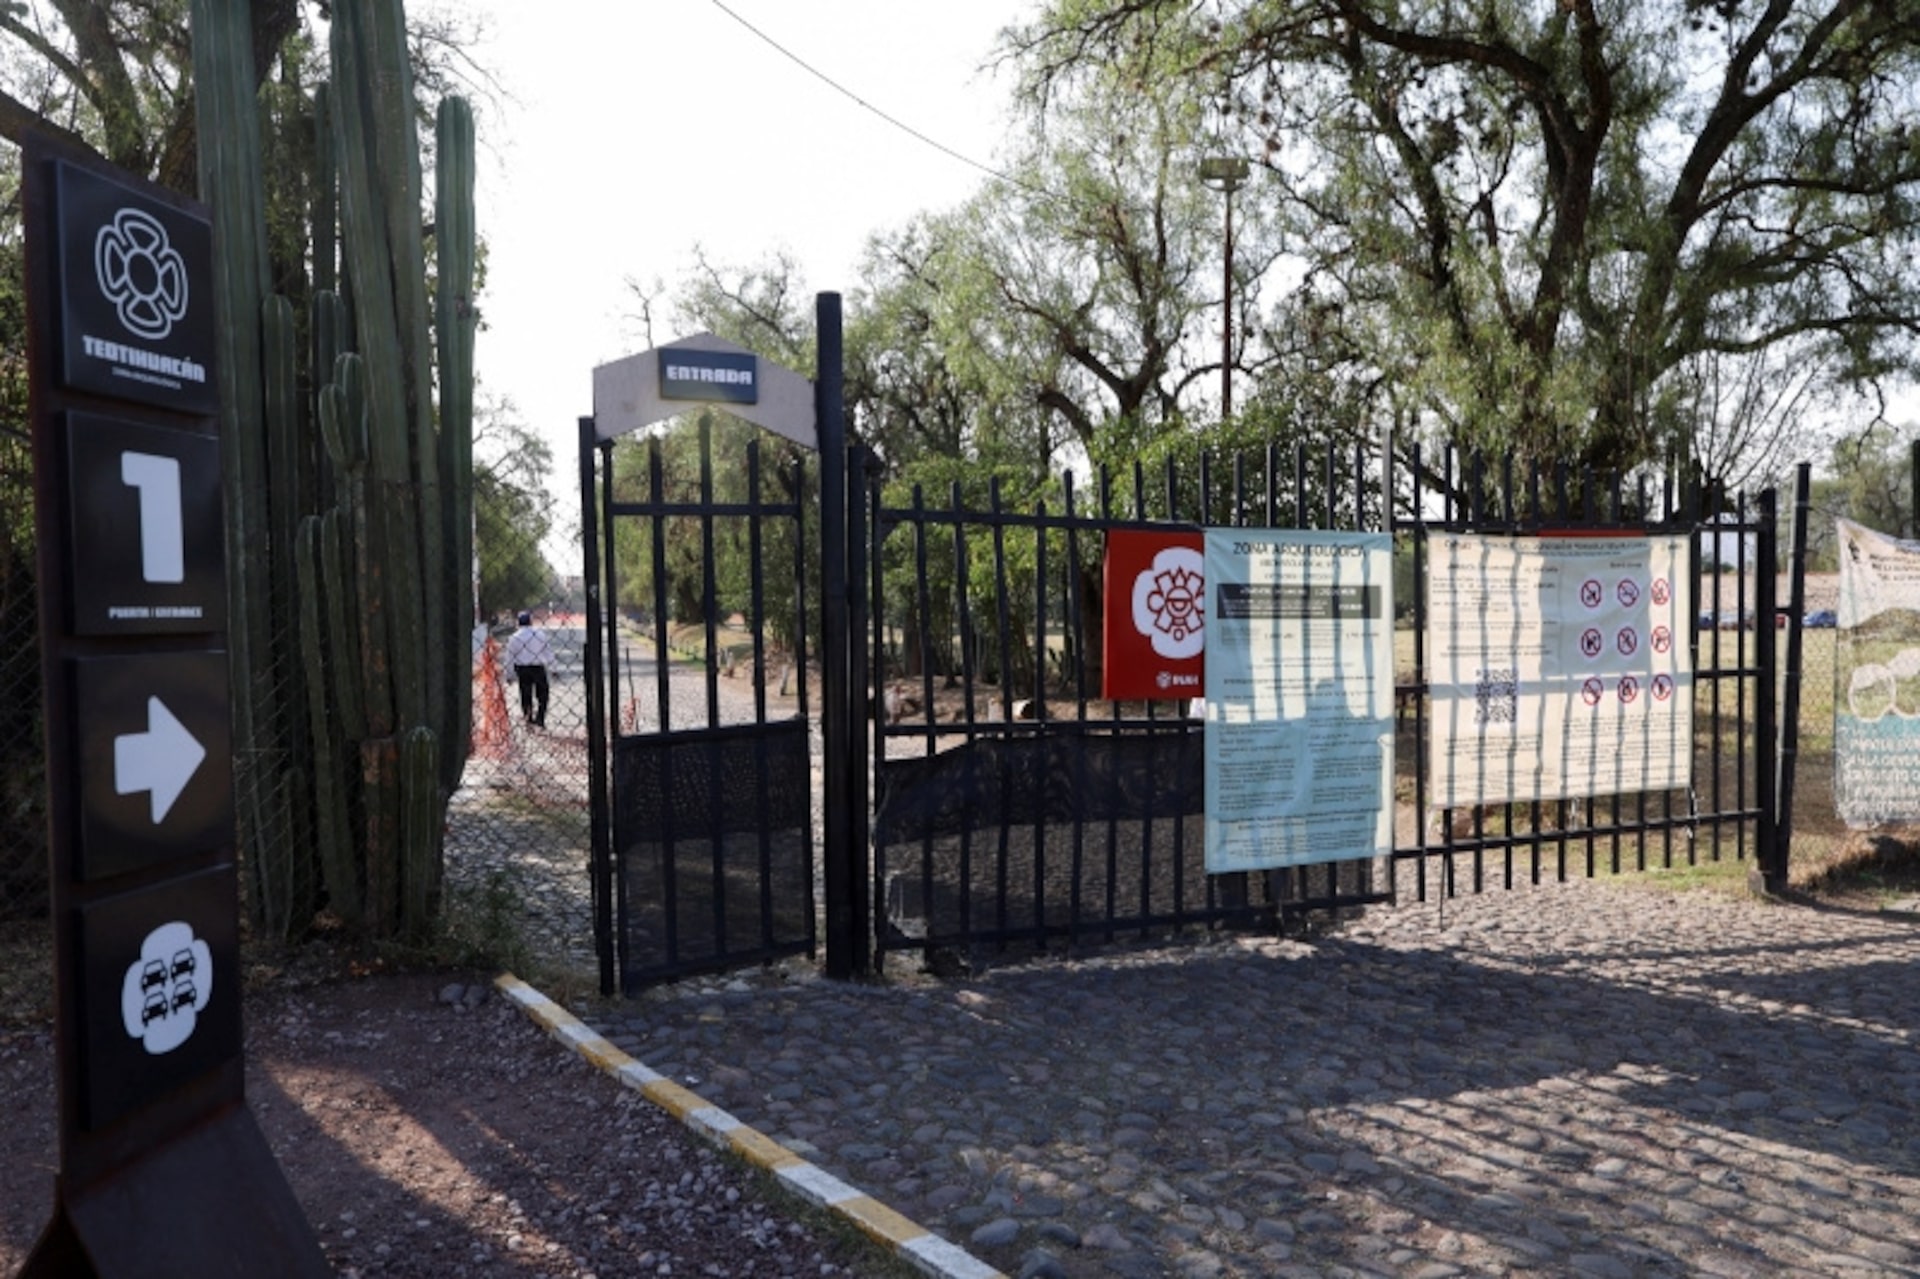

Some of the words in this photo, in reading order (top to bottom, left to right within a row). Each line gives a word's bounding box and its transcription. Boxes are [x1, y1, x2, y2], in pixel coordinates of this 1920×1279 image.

[666, 365, 753, 385] ENTRADA
[121, 450, 184, 583] 1
[1233, 541, 1268, 556] ZONA
